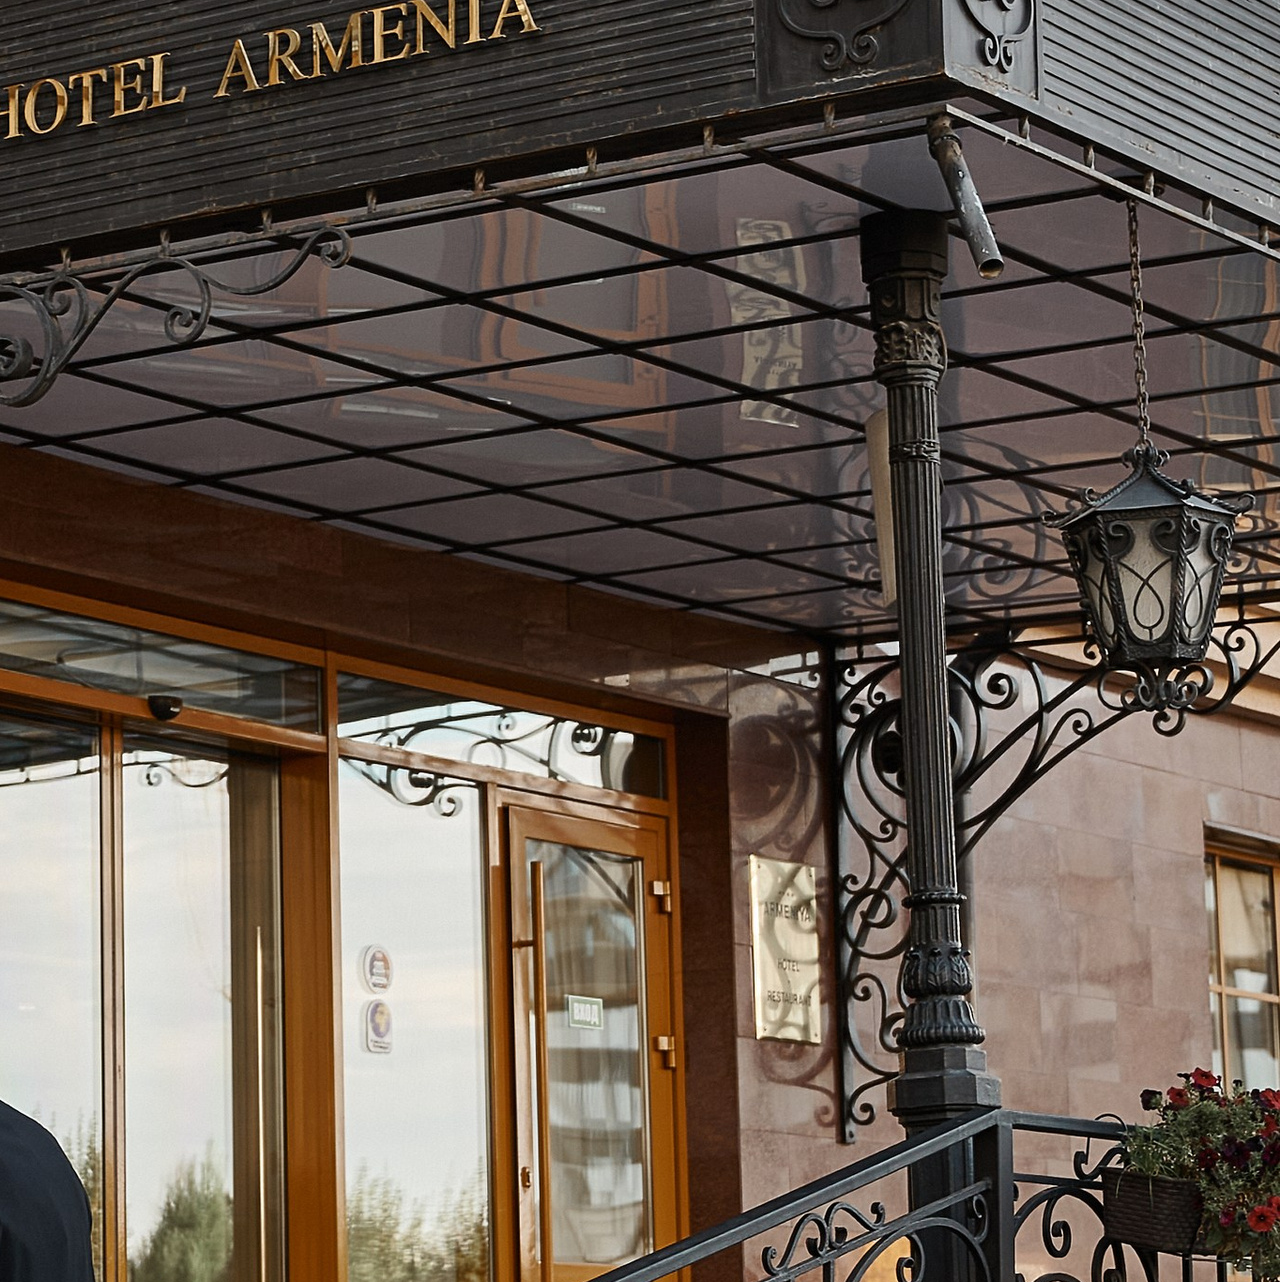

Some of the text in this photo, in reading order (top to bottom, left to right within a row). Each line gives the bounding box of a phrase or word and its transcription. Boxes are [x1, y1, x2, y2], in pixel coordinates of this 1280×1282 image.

[778, 959, 799, 972] HOTEL
[767, 990, 811, 1007] RESTAURANT
[573, 1002, 599, 1025] ВХОД
